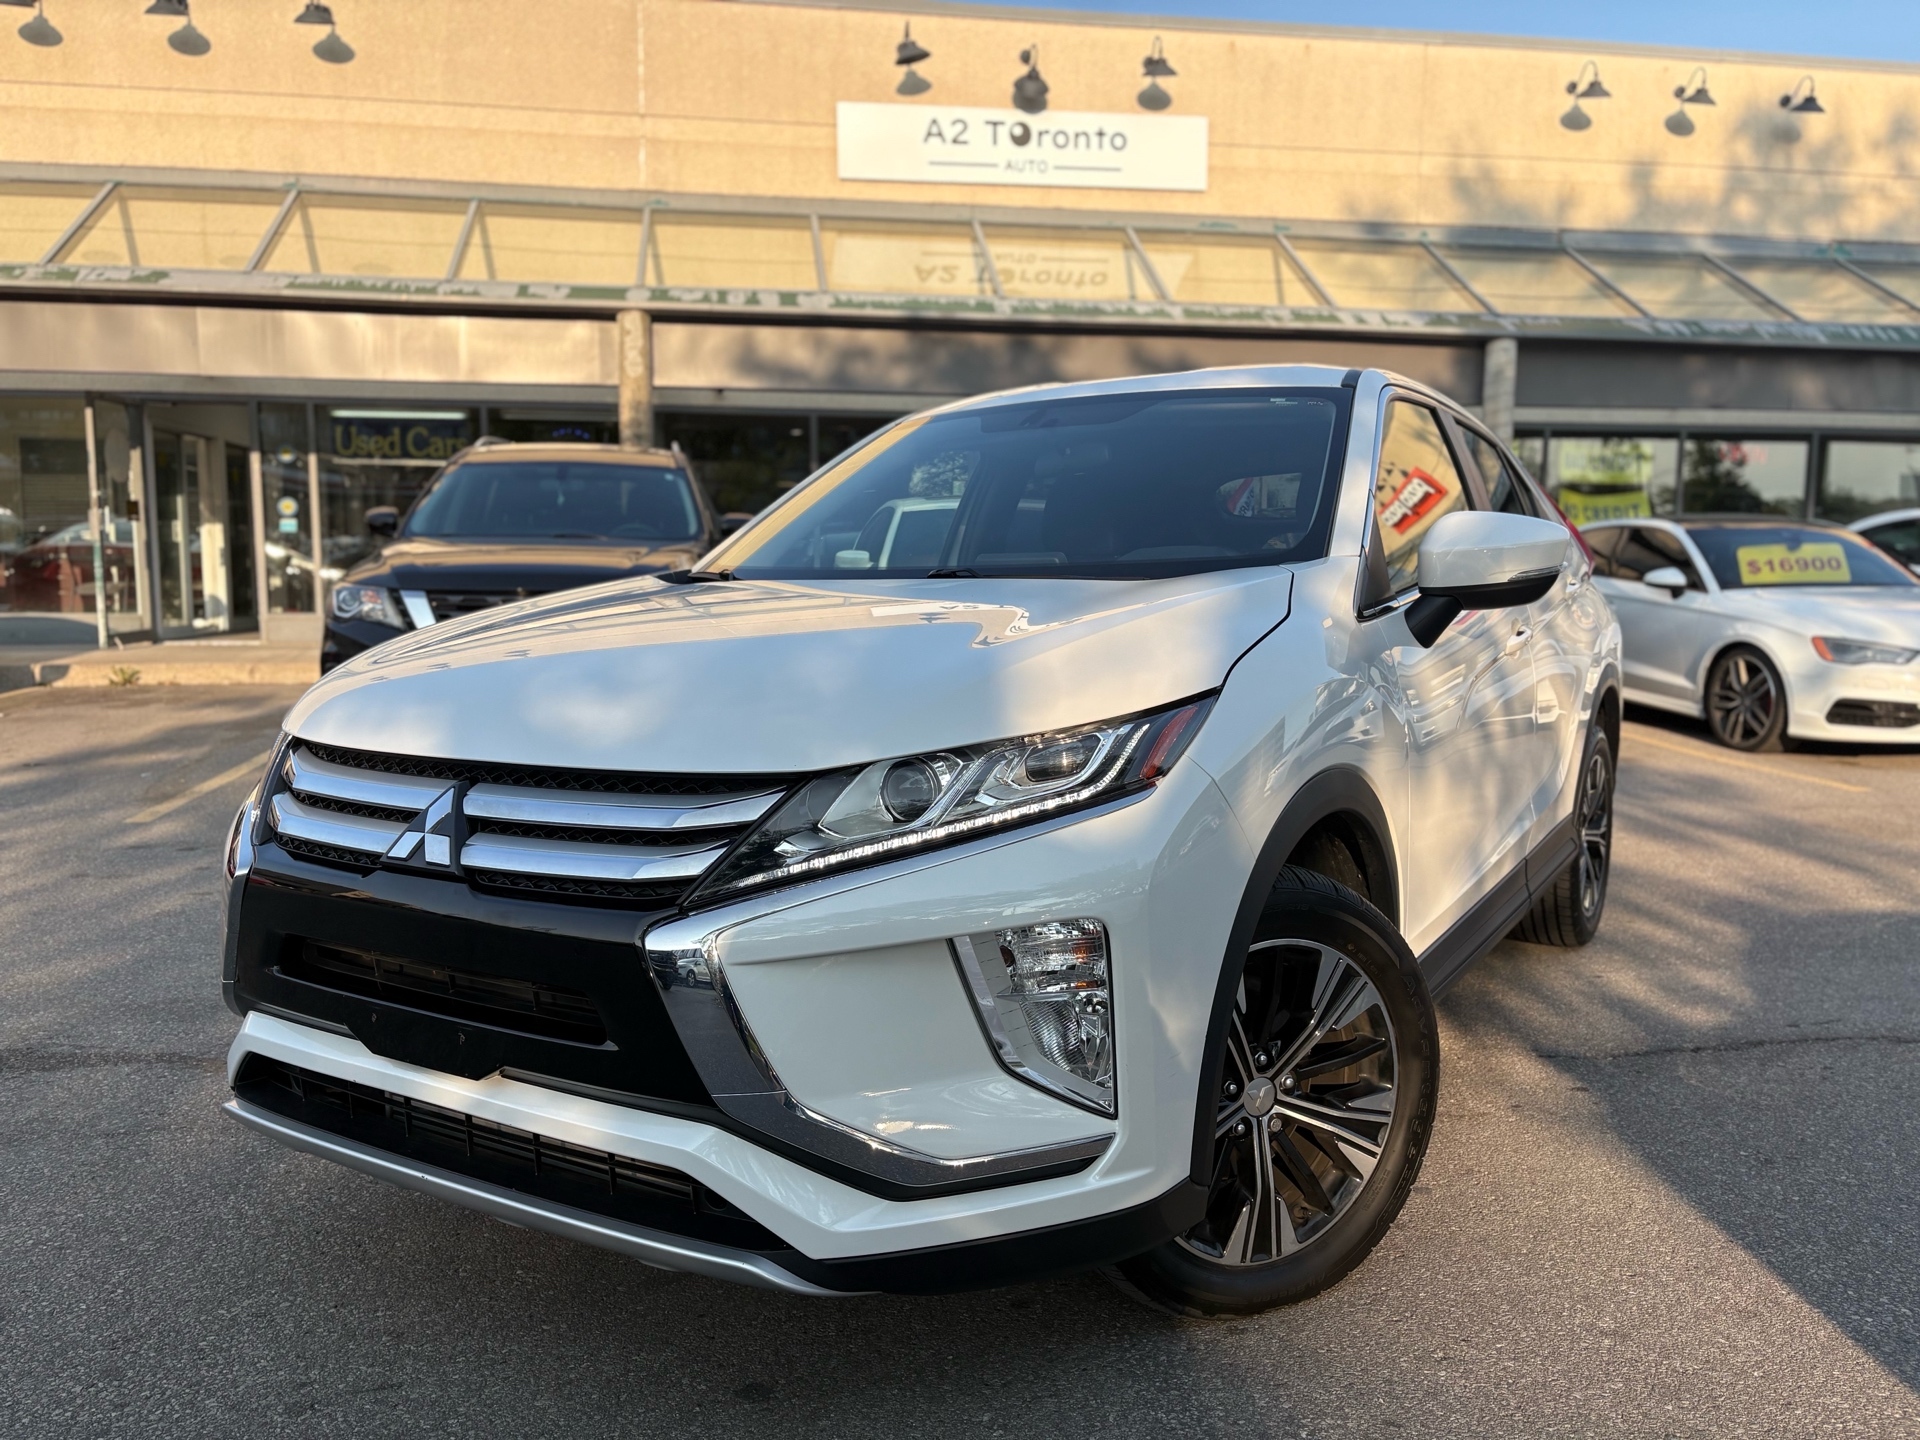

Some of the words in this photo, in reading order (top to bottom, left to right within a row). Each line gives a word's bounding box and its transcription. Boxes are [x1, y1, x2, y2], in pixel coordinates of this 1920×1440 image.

[924, 117, 969, 145] A2
[1004, 159, 1049, 174] AUTO
[334, 425, 400, 457] Used
[1746, 557, 1842, 575] $16900
